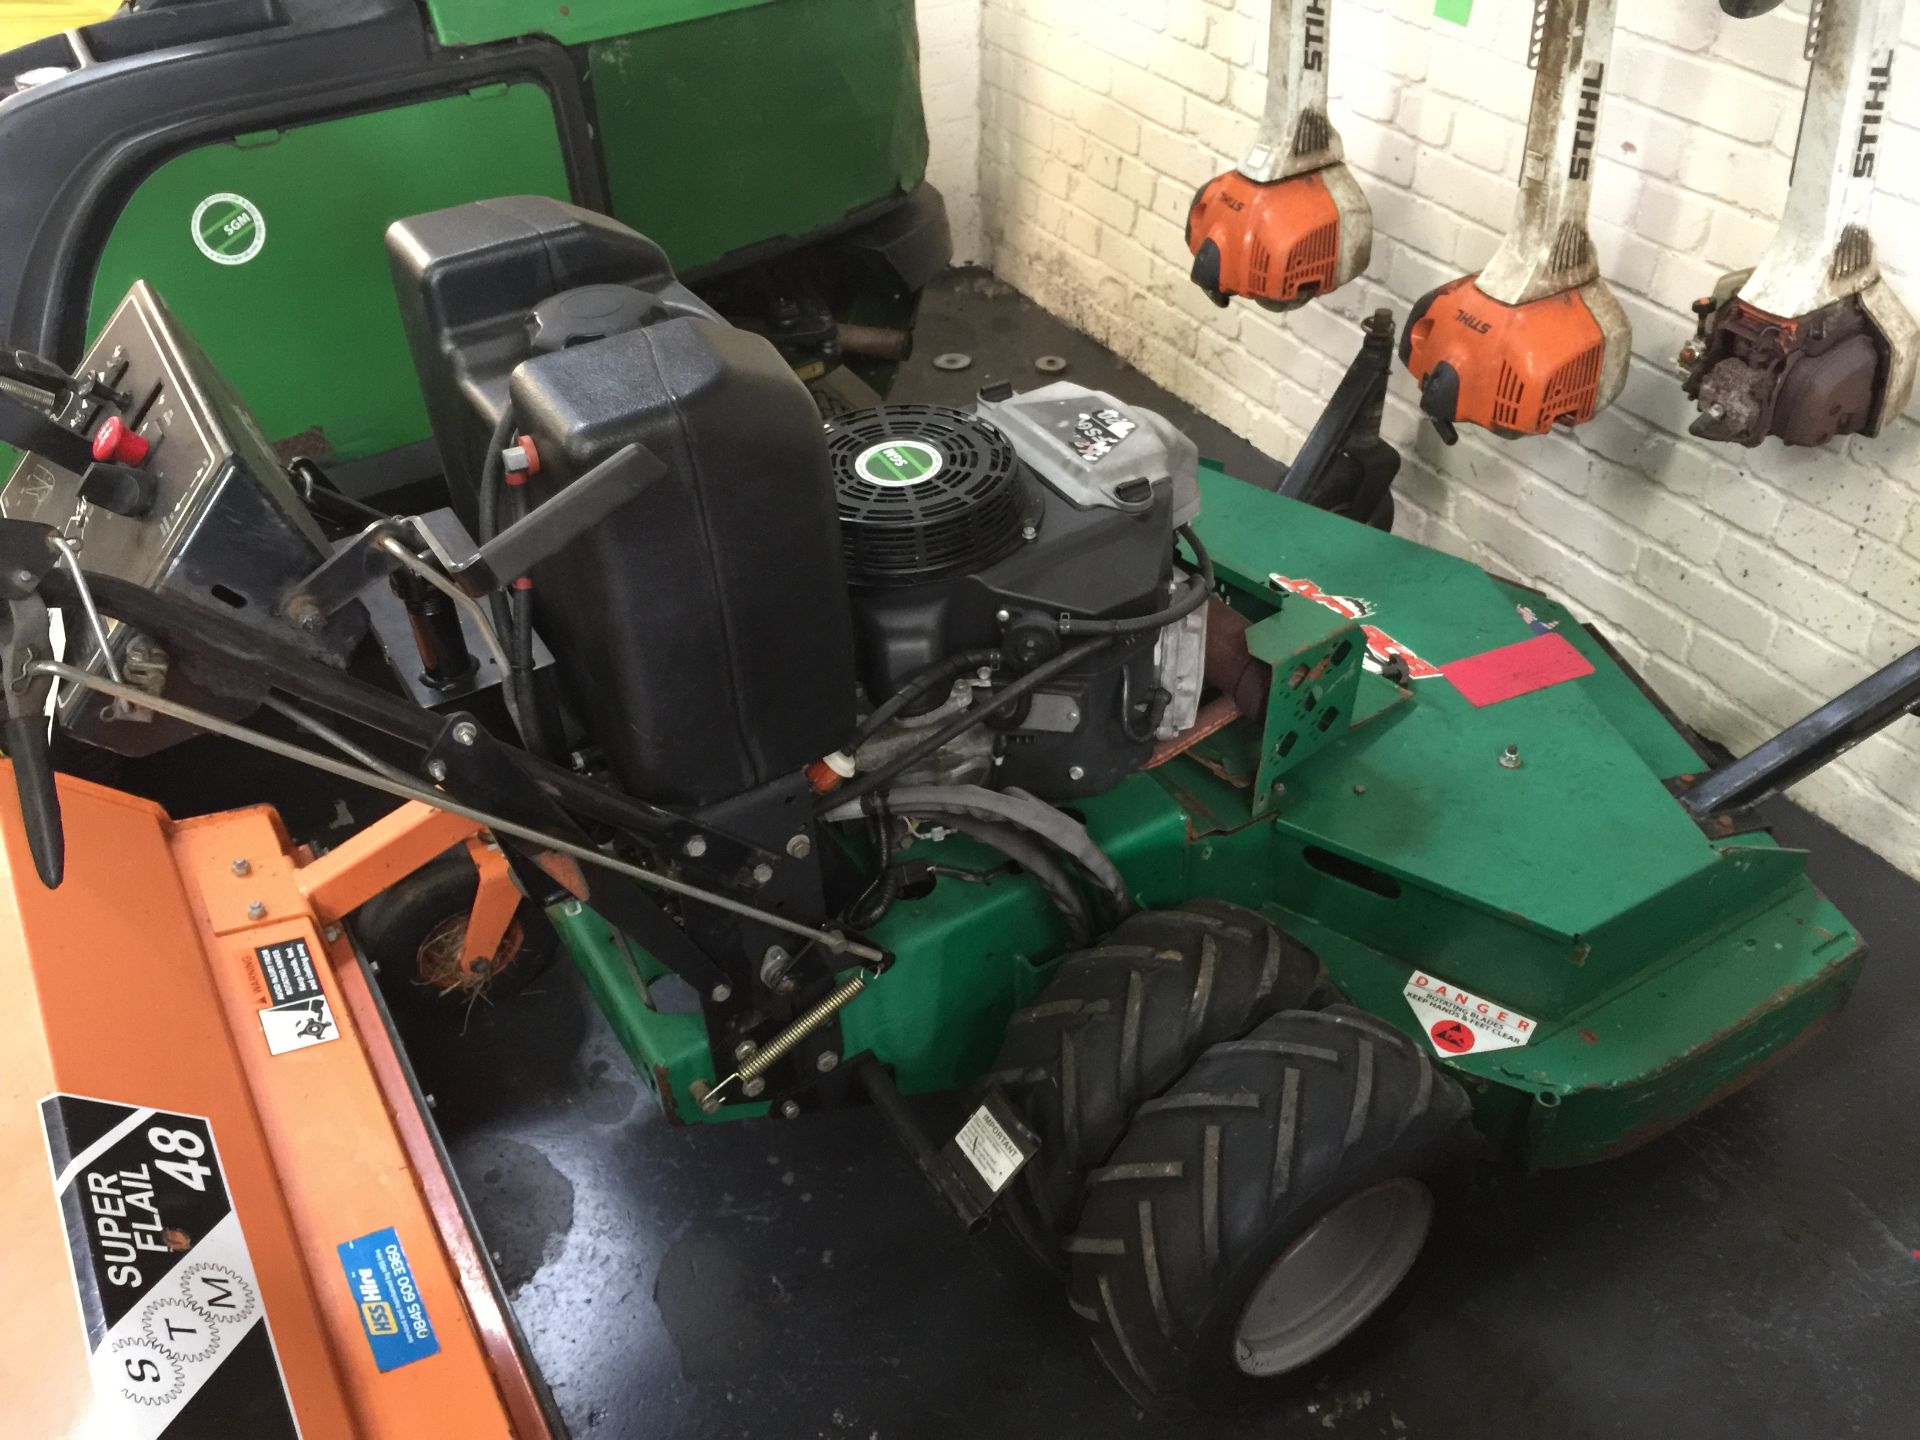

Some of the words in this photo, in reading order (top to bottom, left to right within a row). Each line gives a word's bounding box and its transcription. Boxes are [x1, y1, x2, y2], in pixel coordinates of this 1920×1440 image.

[1569, 62, 1604, 181] STIHL
[1853, 49, 1894, 178] STIHL
[1221, 191, 1245, 212] STIHL
[224, 212, 251, 236] SGM
[1455, 309, 1492, 335] STIHL
[882, 448, 908, 467] SGM
[242, 955, 261, 993] WARNING
[1406, 991, 1428, 1004] KEEP
[1429, 1001, 1460, 1017] HANDS
[1469, 1018, 1491, 1031] FEET
[1492, 1028, 1520, 1044] CLEAR
[1414, 974, 1530, 1032] DANGER
[1427, 993, 1468, 1013] ROTATING
[1470, 1012, 1504, 1029] BLADES
[982, 1113, 1017, 1157] IMPORTANT
[147, 1126, 212, 1192] 48
[118, 1162, 170, 1253] FLAIL
[87, 1172, 142, 1288] SUPER
[385, 1244, 406, 1276] 3360
[358, 1268, 381, 1301] Hire
[397, 1276, 415, 1302] 600
[367, 1304, 392, 1332] HSS
[406, 1303, 429, 1338] 0845
